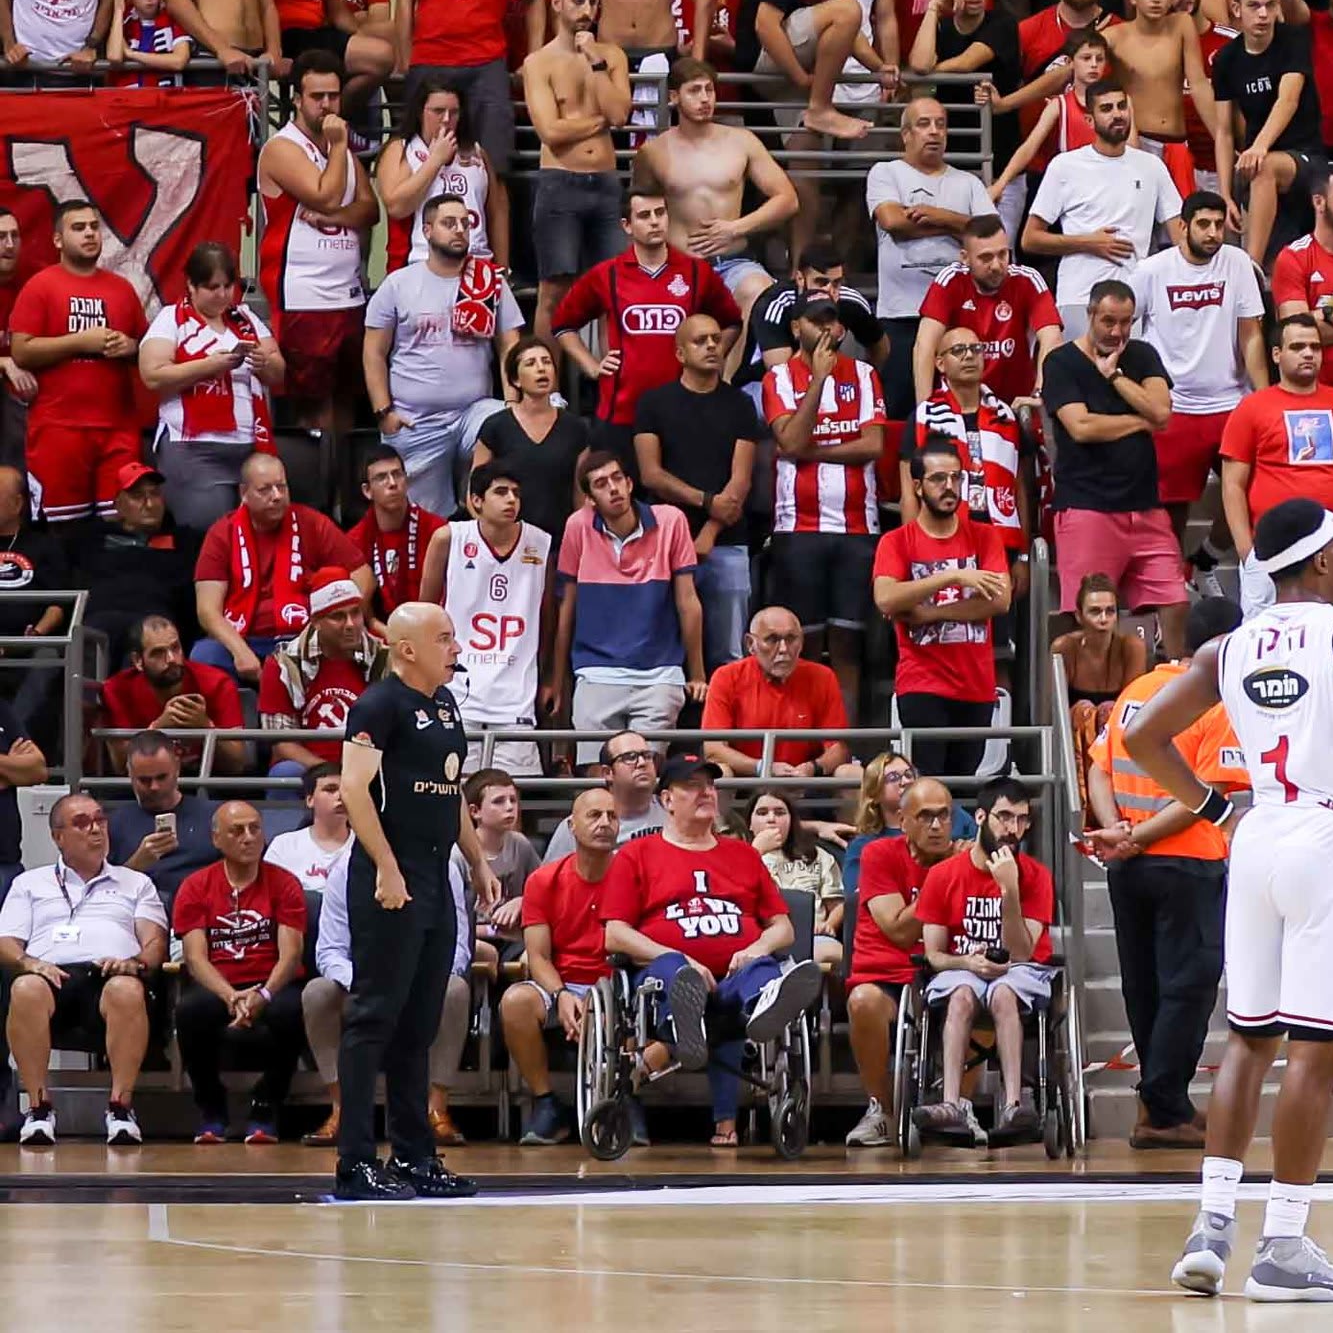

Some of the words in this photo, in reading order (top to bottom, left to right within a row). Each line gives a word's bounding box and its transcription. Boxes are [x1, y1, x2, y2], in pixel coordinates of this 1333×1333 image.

[1245, 79, 1273, 95] ICON
[440, 174, 467, 196] 13
[69, 297, 104, 315] אהבה
[632, 308, 681, 331] כתר
[490, 574, 508, 602] 6
[469, 611, 526, 652] SP
[1249, 675, 1299, 697] תומר
[1260, 735, 1300, 803] 1
[694, 870, 707, 894] I
[965, 896, 1003, 918] אהבה
[678, 914, 739, 939] YOU
